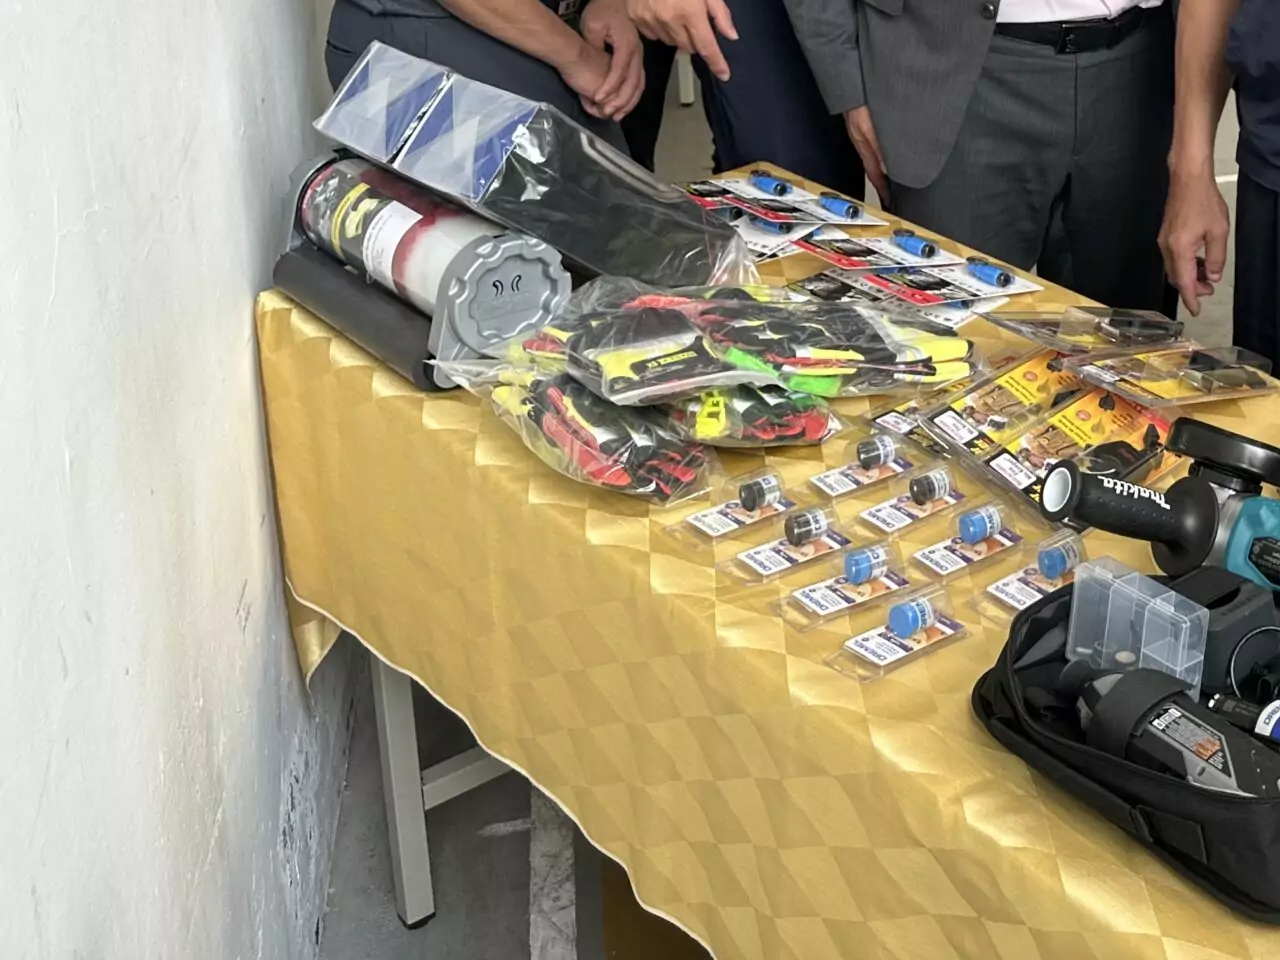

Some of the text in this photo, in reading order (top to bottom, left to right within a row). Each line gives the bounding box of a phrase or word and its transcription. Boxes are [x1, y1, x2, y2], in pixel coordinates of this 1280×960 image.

[1098, 475, 1171, 510] makita
[865, 511, 896, 530] DREMEL
[920, 551, 949, 572] DREMEL
[853, 639, 888, 662] DREMEL
